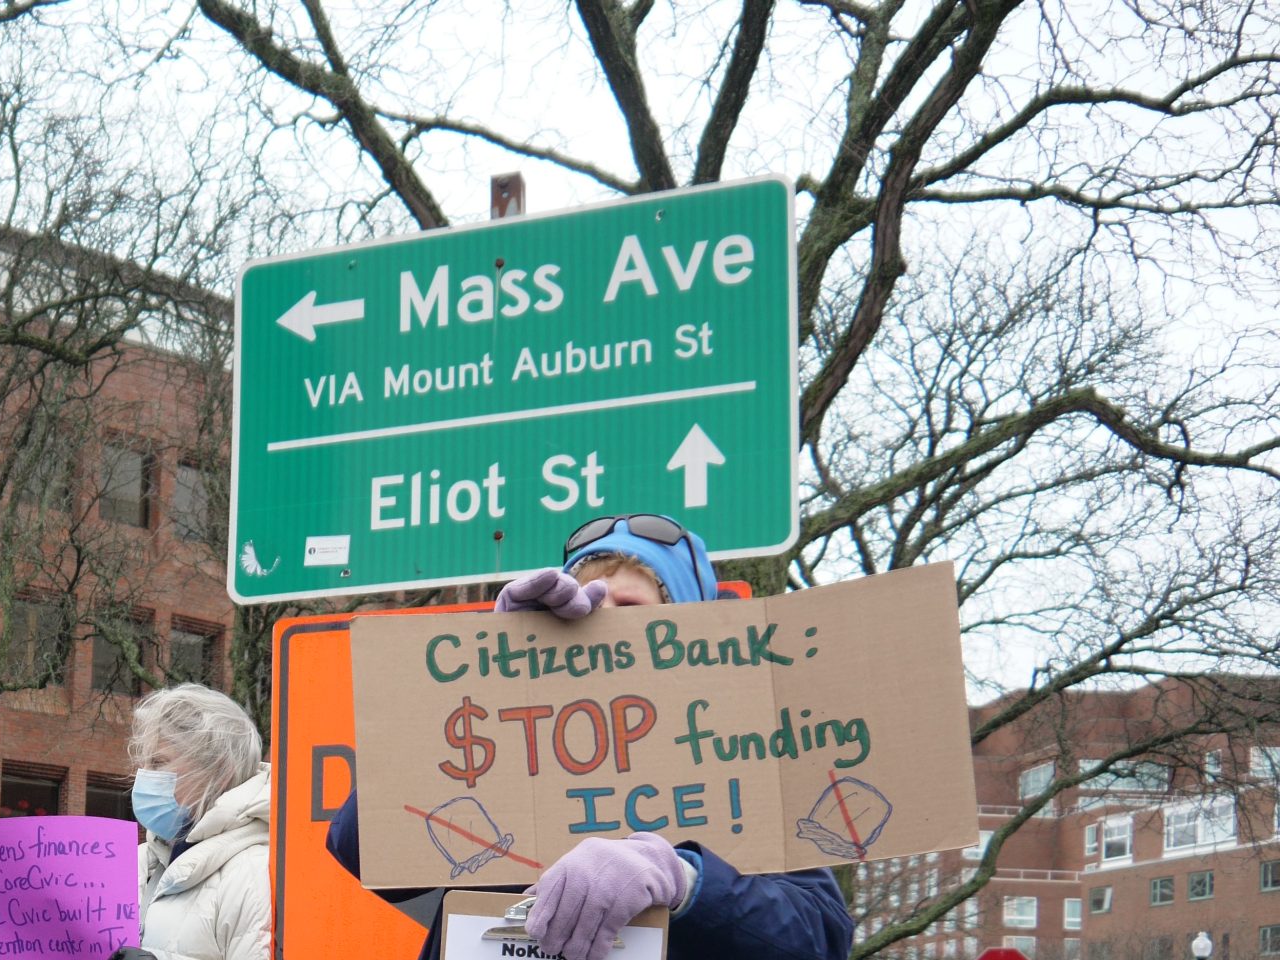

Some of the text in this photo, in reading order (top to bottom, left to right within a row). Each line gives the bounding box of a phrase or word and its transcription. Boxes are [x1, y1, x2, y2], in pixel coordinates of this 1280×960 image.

[400, 233, 754, 333] Mass Ave
[304, 322, 713, 408] VIA Mount Auburn St
[370, 451, 604, 530] Eliot St
[425, 631, 636, 683] Citizens
[438, 695, 657, 788] $TOP
[674, 699, 870, 769] funding
[565, 778, 743, 834] ICE!
[29, 826, 116, 859] finances
[8, 898, 52, 927] Civic
[55, 896, 106, 922] built
[116, 903, 136, 920] ICE
[48, 929, 83, 955] center
[90, 943, 102, 953] in
